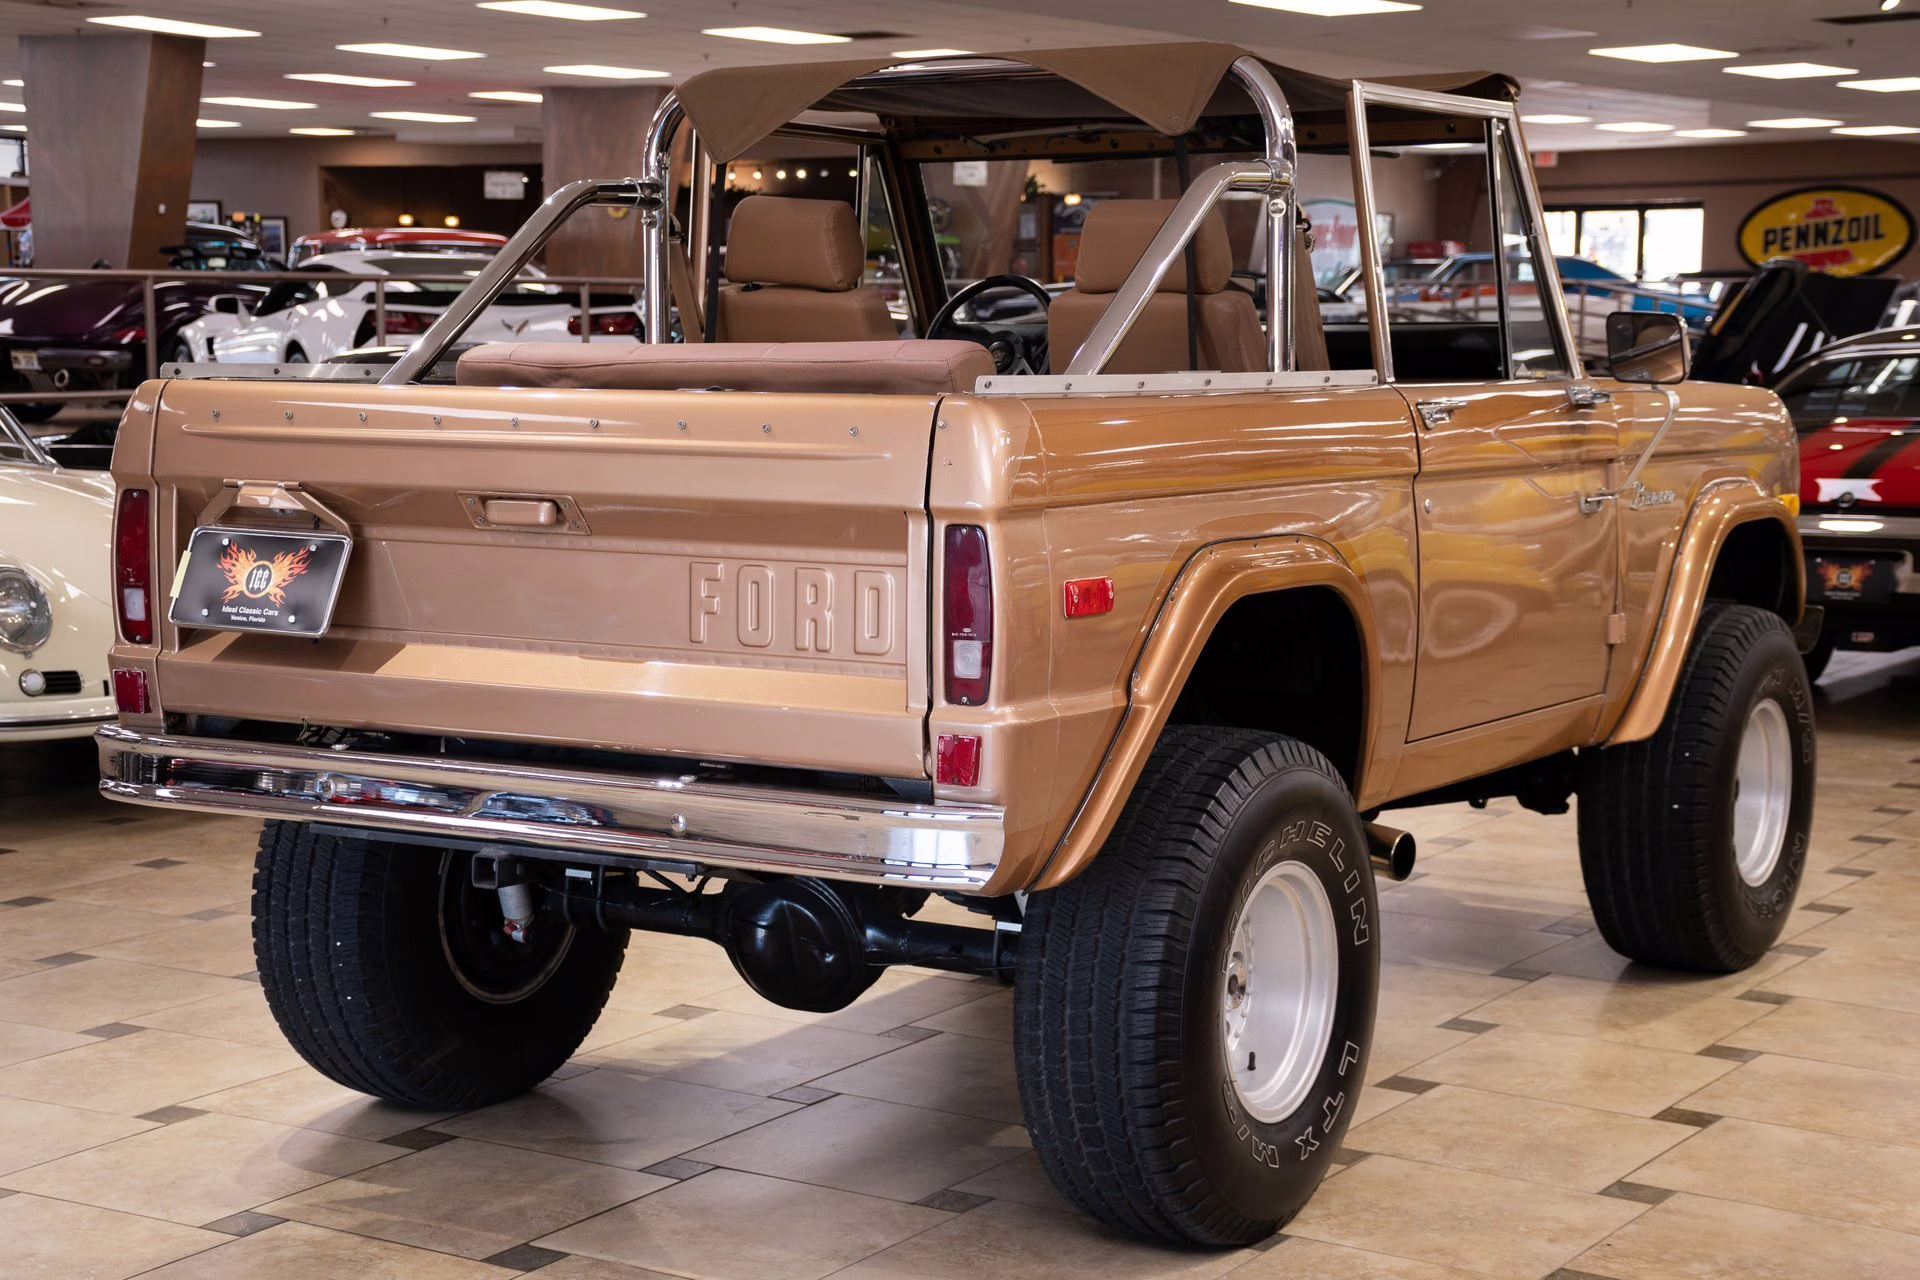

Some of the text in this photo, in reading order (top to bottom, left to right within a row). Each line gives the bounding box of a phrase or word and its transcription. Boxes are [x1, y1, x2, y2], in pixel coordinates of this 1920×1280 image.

[1762, 213, 1886, 256] PENNZOIL
[238, 606, 262, 615] Classic
[263, 608, 278, 616] Cars
[689, 561, 895, 656] FORD
[1294, 1040, 1360, 1161] LTX
